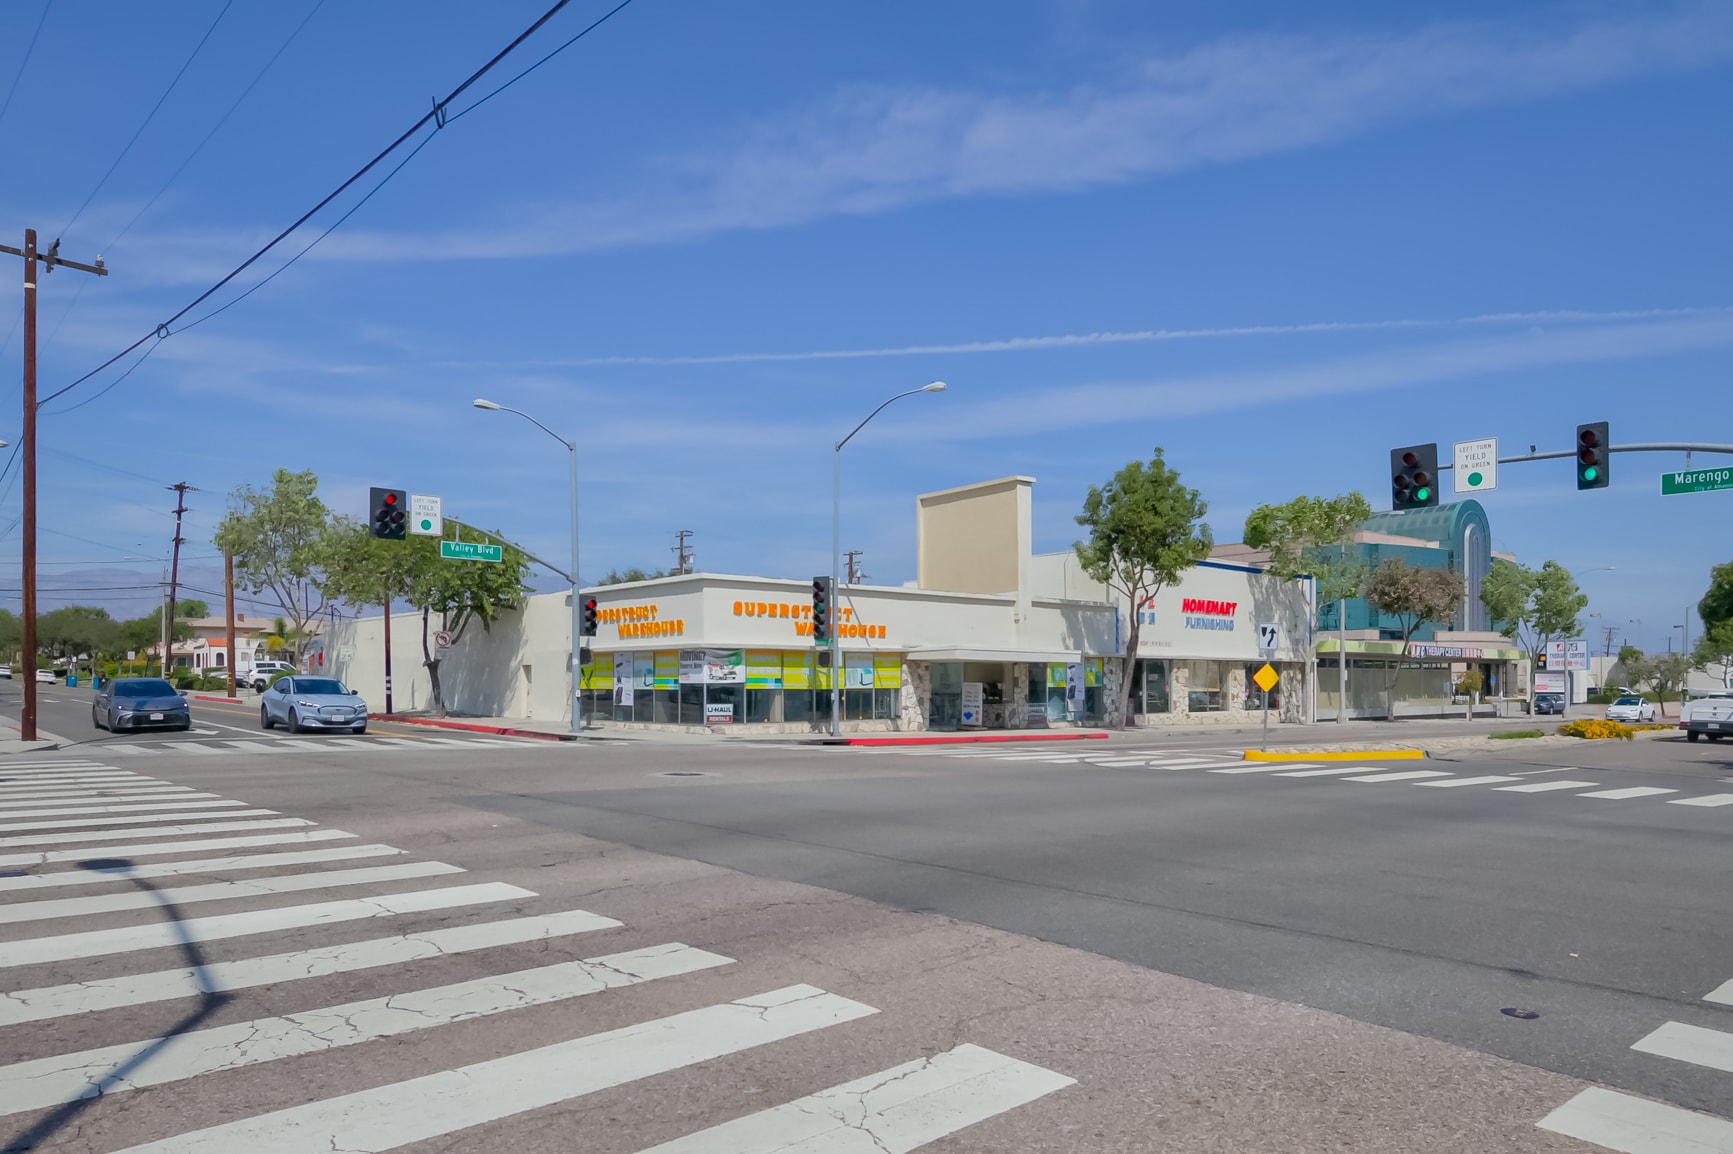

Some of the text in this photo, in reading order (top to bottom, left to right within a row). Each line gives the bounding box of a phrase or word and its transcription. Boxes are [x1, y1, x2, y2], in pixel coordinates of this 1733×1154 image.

[1465, 452, 1486, 460] YIELD
[1674, 471, 1729, 484] Marengo
[450, 543, 494, 555] Valley Blvd
[1182, 598, 1237, 616] HOMEMART
[618, 619, 684, 639] WAREHOUSE
[1185, 616, 1234, 631] FURNISHING
[1426, 646, 1445, 656] THERAPY
[1445, 647, 1462, 657] CENTER
